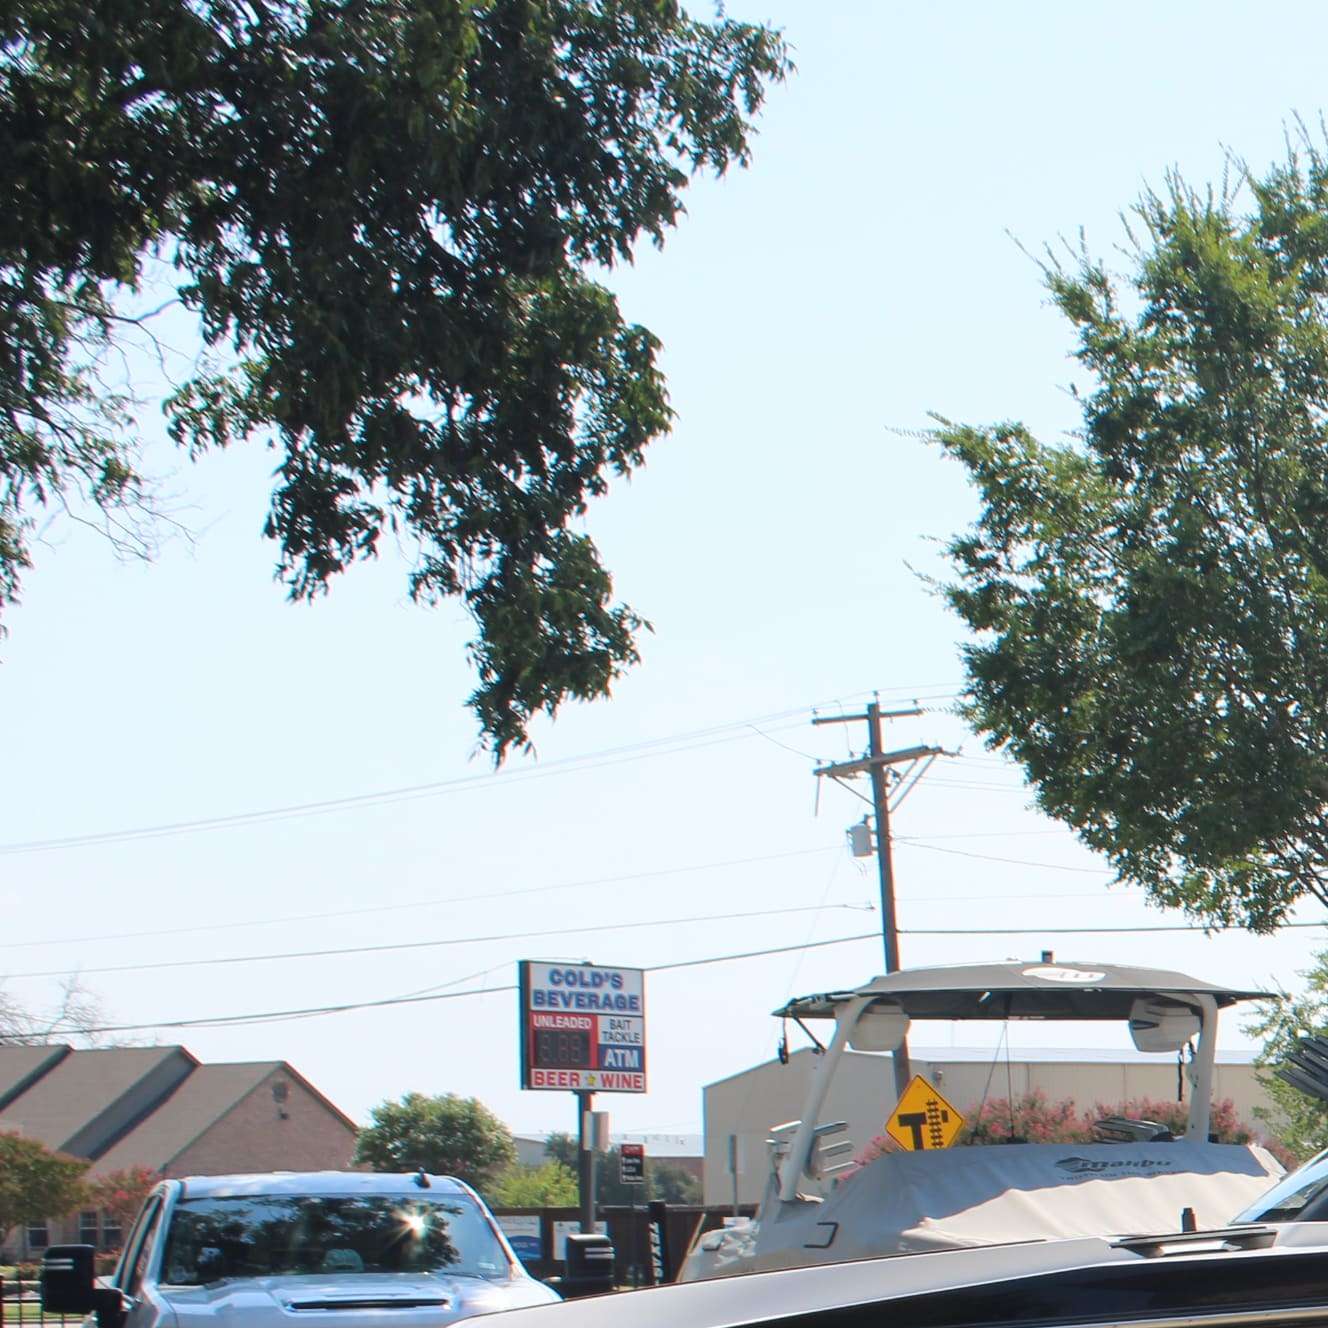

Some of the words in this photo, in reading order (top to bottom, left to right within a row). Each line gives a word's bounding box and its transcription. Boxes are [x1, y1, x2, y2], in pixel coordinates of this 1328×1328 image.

[532, 989, 641, 1011] BEVERAGE
[532, 1013, 593, 1030] UNLEADED
[609, 1018, 633, 1031] BAIT
[602, 1030, 641, 1043] TACKLE
[603, 1047, 640, 1068] ATM
[533, 1070, 581, 1087] BEER
[600, 1073, 643, 1089] WINE
